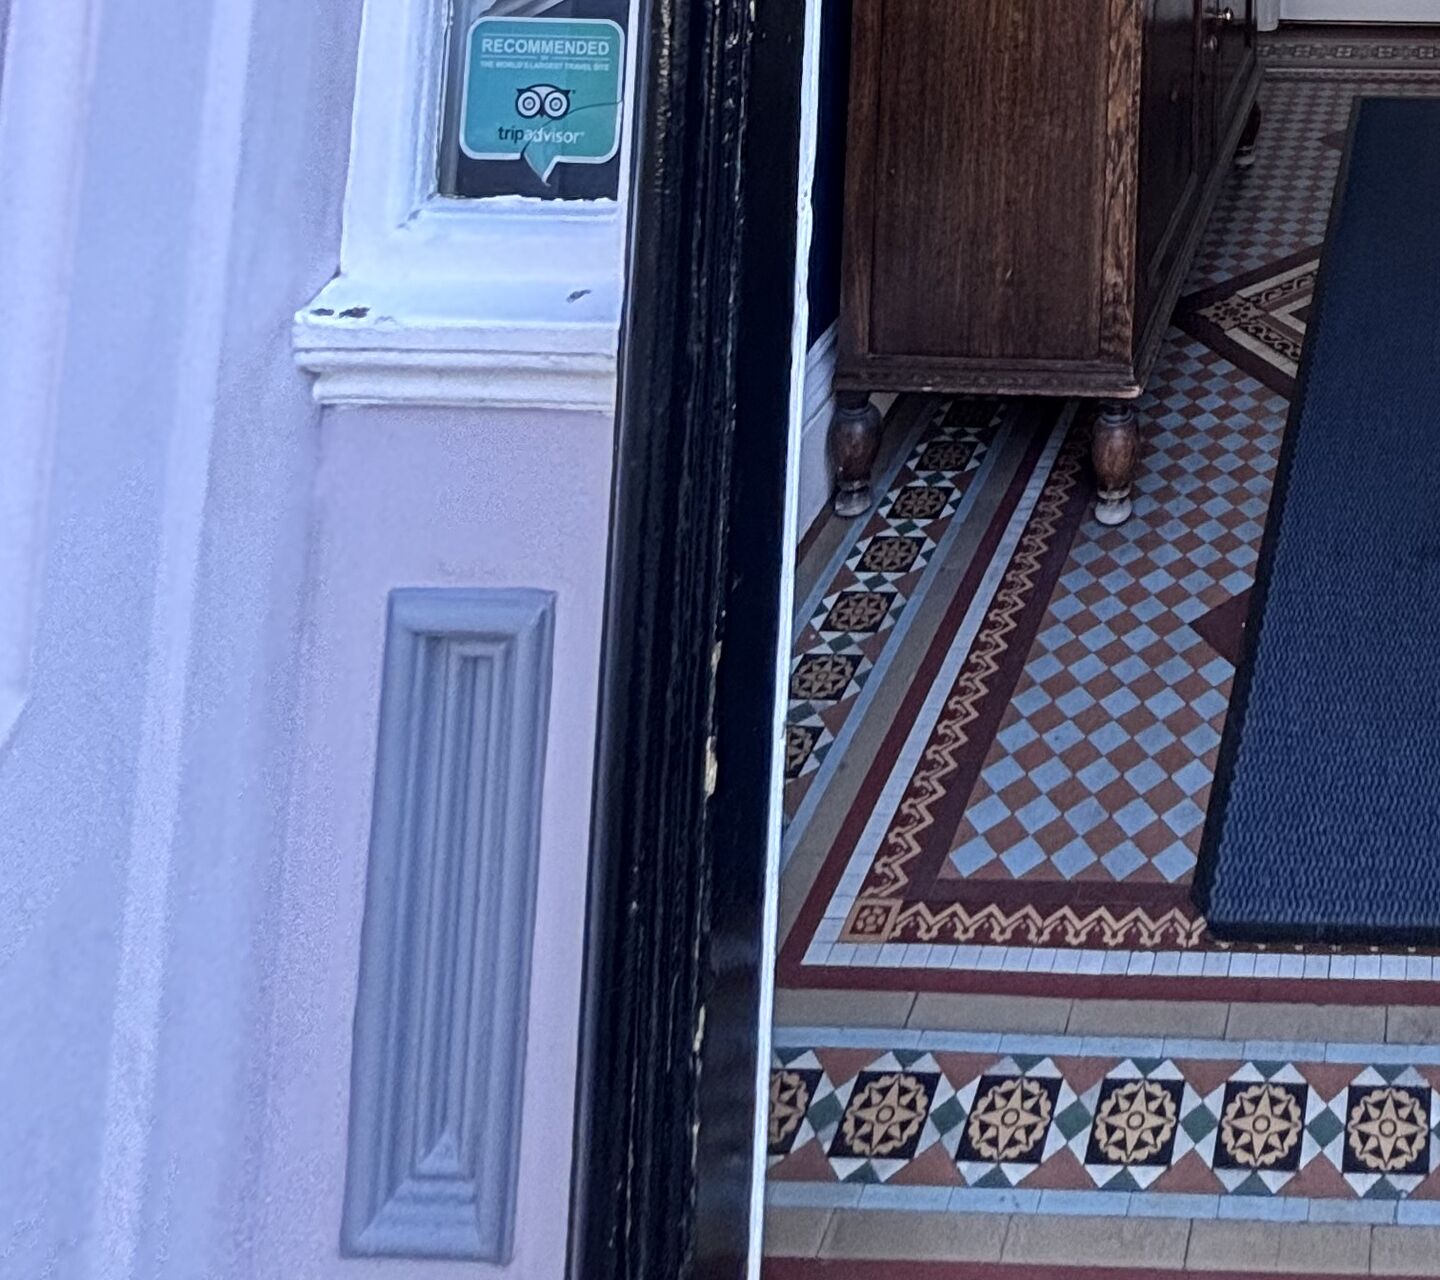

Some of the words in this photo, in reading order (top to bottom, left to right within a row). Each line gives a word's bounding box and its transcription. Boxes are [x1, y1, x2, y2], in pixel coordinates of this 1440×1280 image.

[481, 38, 610, 56] RECOMMENDED
[480, 60, 494, 69] THE
[530, 61, 563, 70] LARGEST
[564, 61, 592, 71] TRAVEL
[593, 63, 610, 72] SITE
[498, 126, 579, 144] tripadvisor
